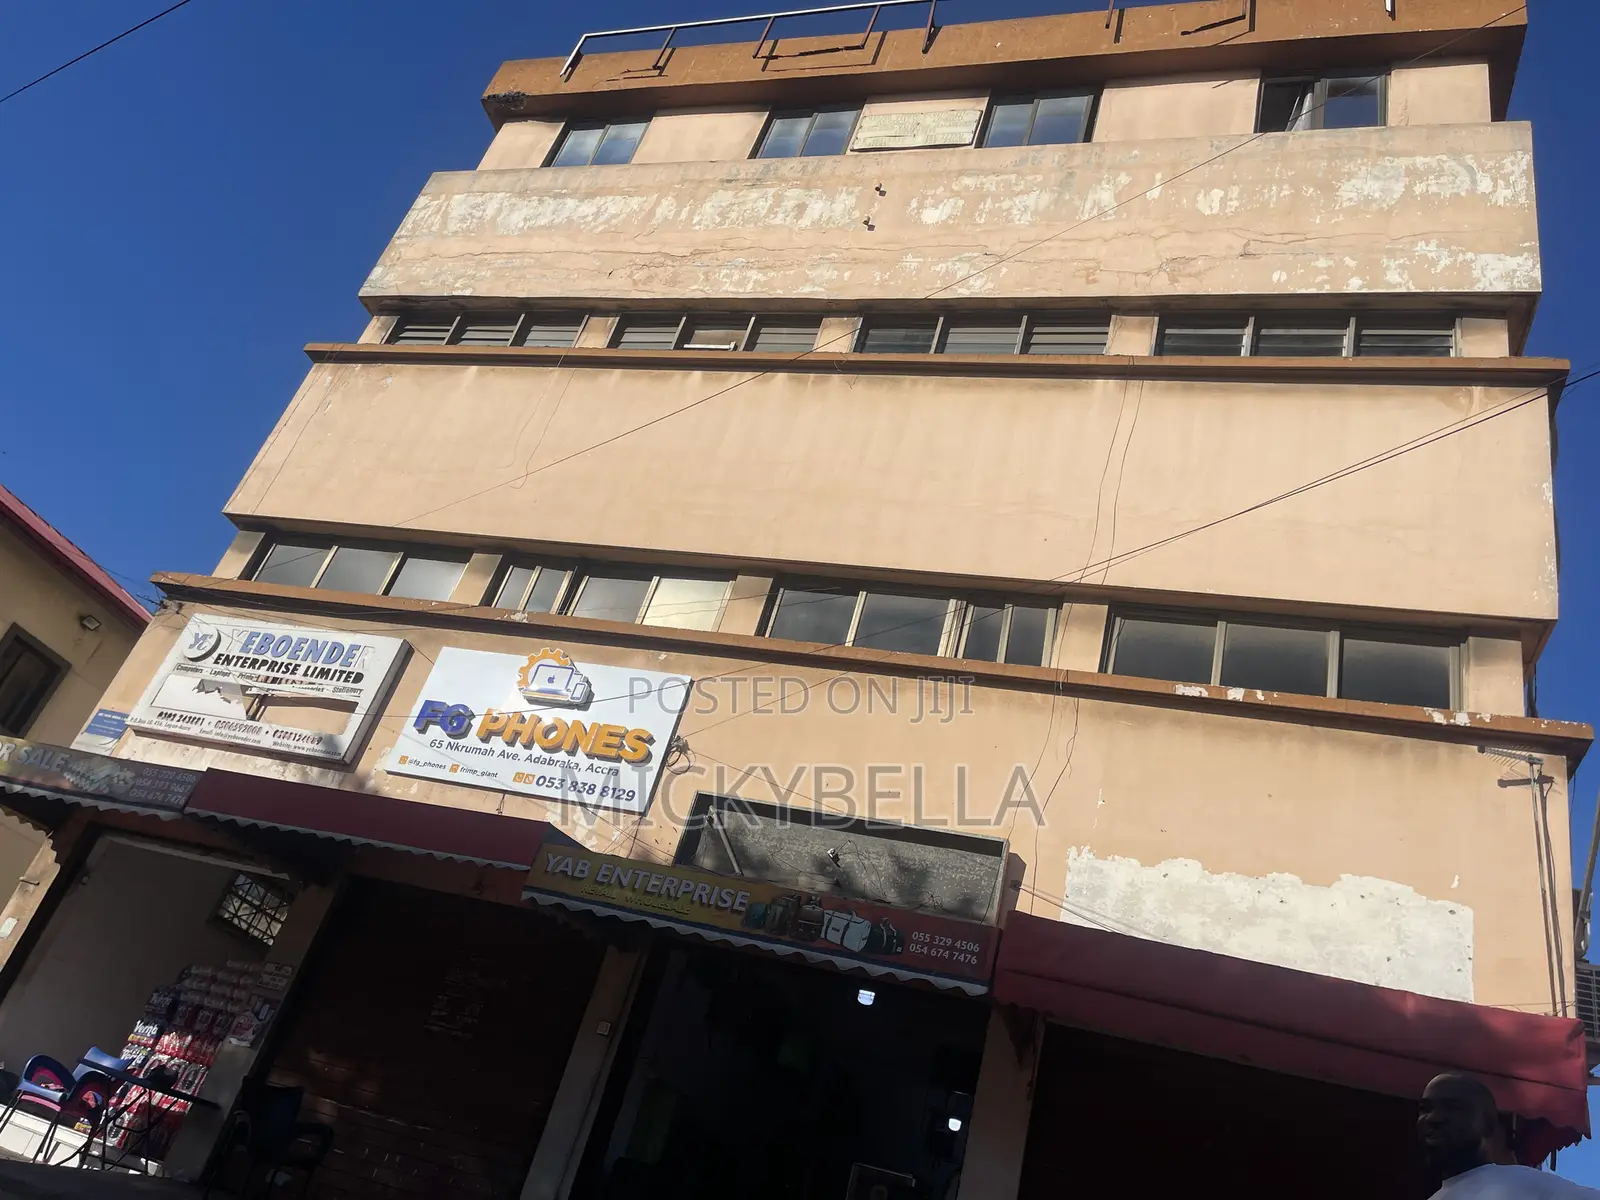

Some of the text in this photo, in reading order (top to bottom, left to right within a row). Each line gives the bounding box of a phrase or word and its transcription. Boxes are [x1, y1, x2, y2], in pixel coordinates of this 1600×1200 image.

[176, 664, 203, 673] Computers
[209, 669, 231, 677] Laptops
[213, 653, 364, 684] ENTERPRISE LIMITED
[413, 700, 655, 766] FG PHONES
[0, 741, 71, 771] R SALE
[408, 758, 446, 770] @fg_phones
[429, 738, 620, 776] 65 Nkrumah Ave. Adabraka, Accra
[460, 766, 498, 779] frimp_giant
[535, 775, 636, 802] 053 838 8129
[545, 852, 751, 914] YAB ENTERPRISE
[909, 943, 978, 965] 054 674 7476
[912, 931, 980, 953] 055 329 4506
